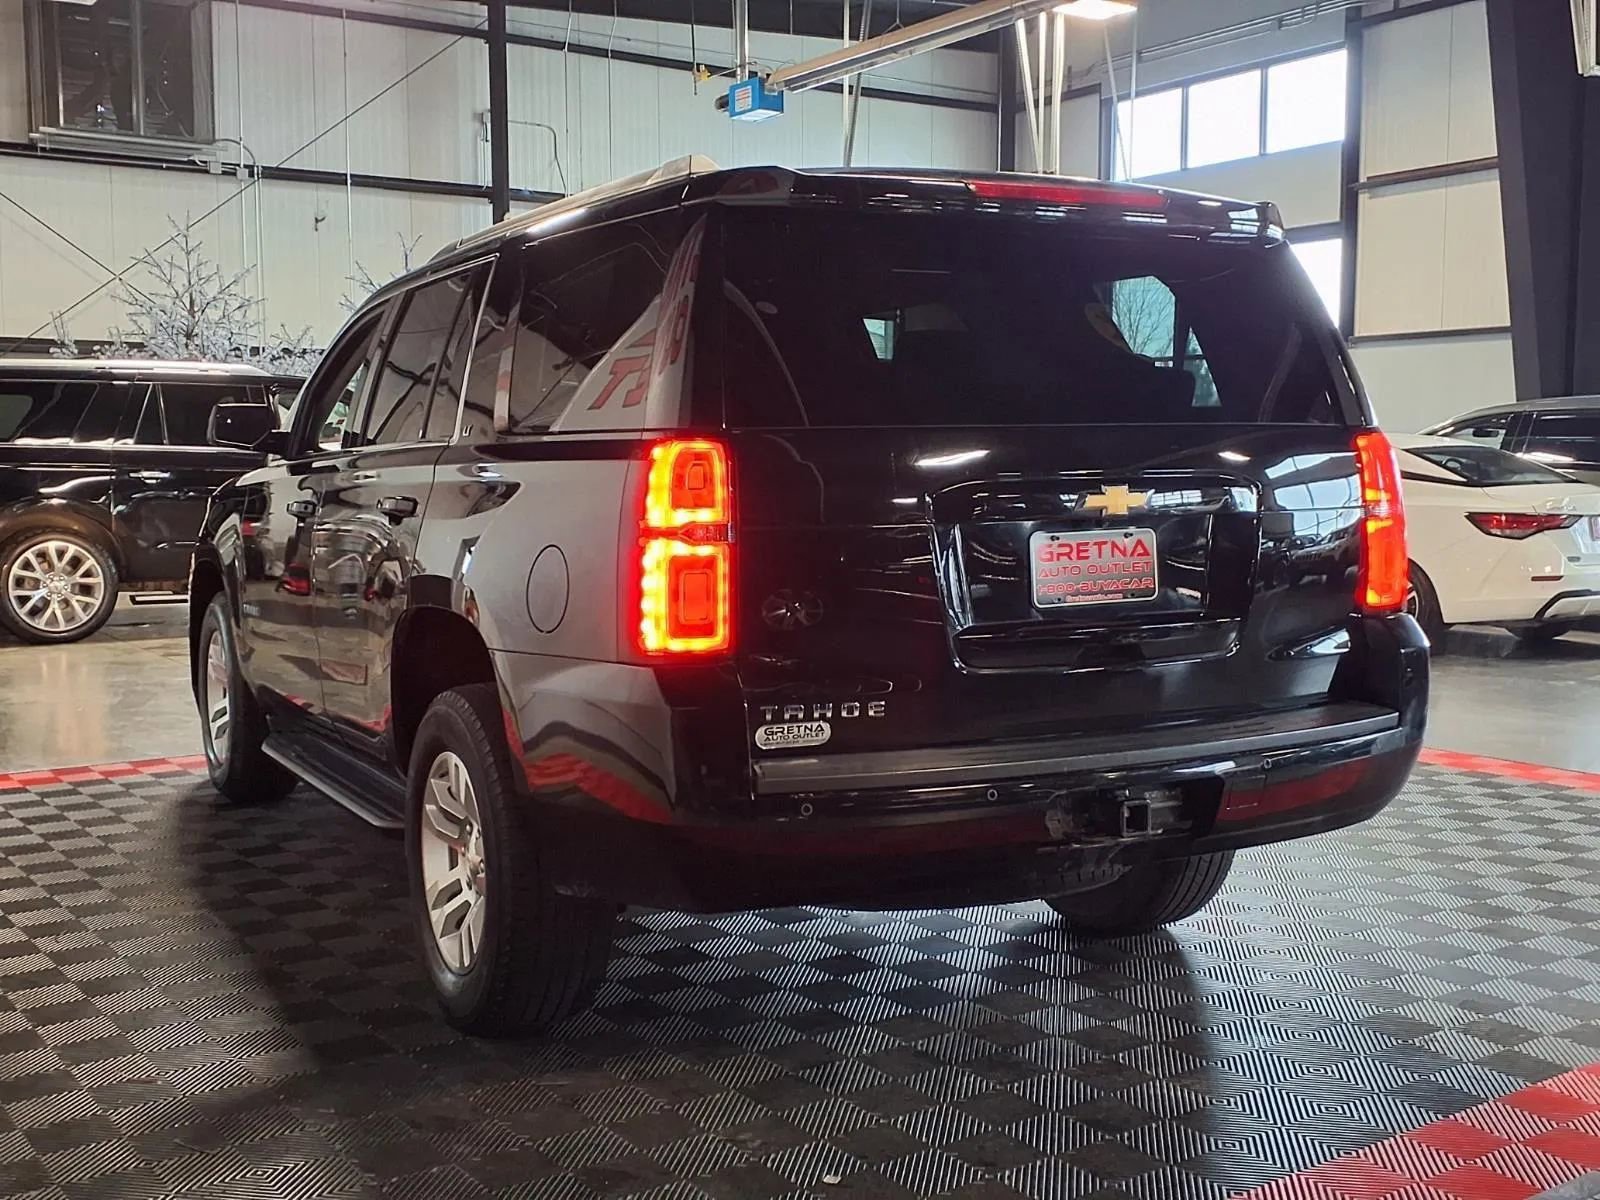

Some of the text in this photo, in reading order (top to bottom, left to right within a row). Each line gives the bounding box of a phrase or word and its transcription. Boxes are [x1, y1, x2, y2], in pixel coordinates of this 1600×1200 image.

[1038, 538, 1151, 563] GRETNA
[1039, 560, 1152, 578] AUTO OUTLET
[1038, 577, 1154, 595] 1-800-BUYACAR
[759, 700, 886, 720] TAHOE
[763, 723, 826, 737] GRETNA
[763, 734, 791, 742] AUTO
[792, 731, 825, 740] OUTLET
